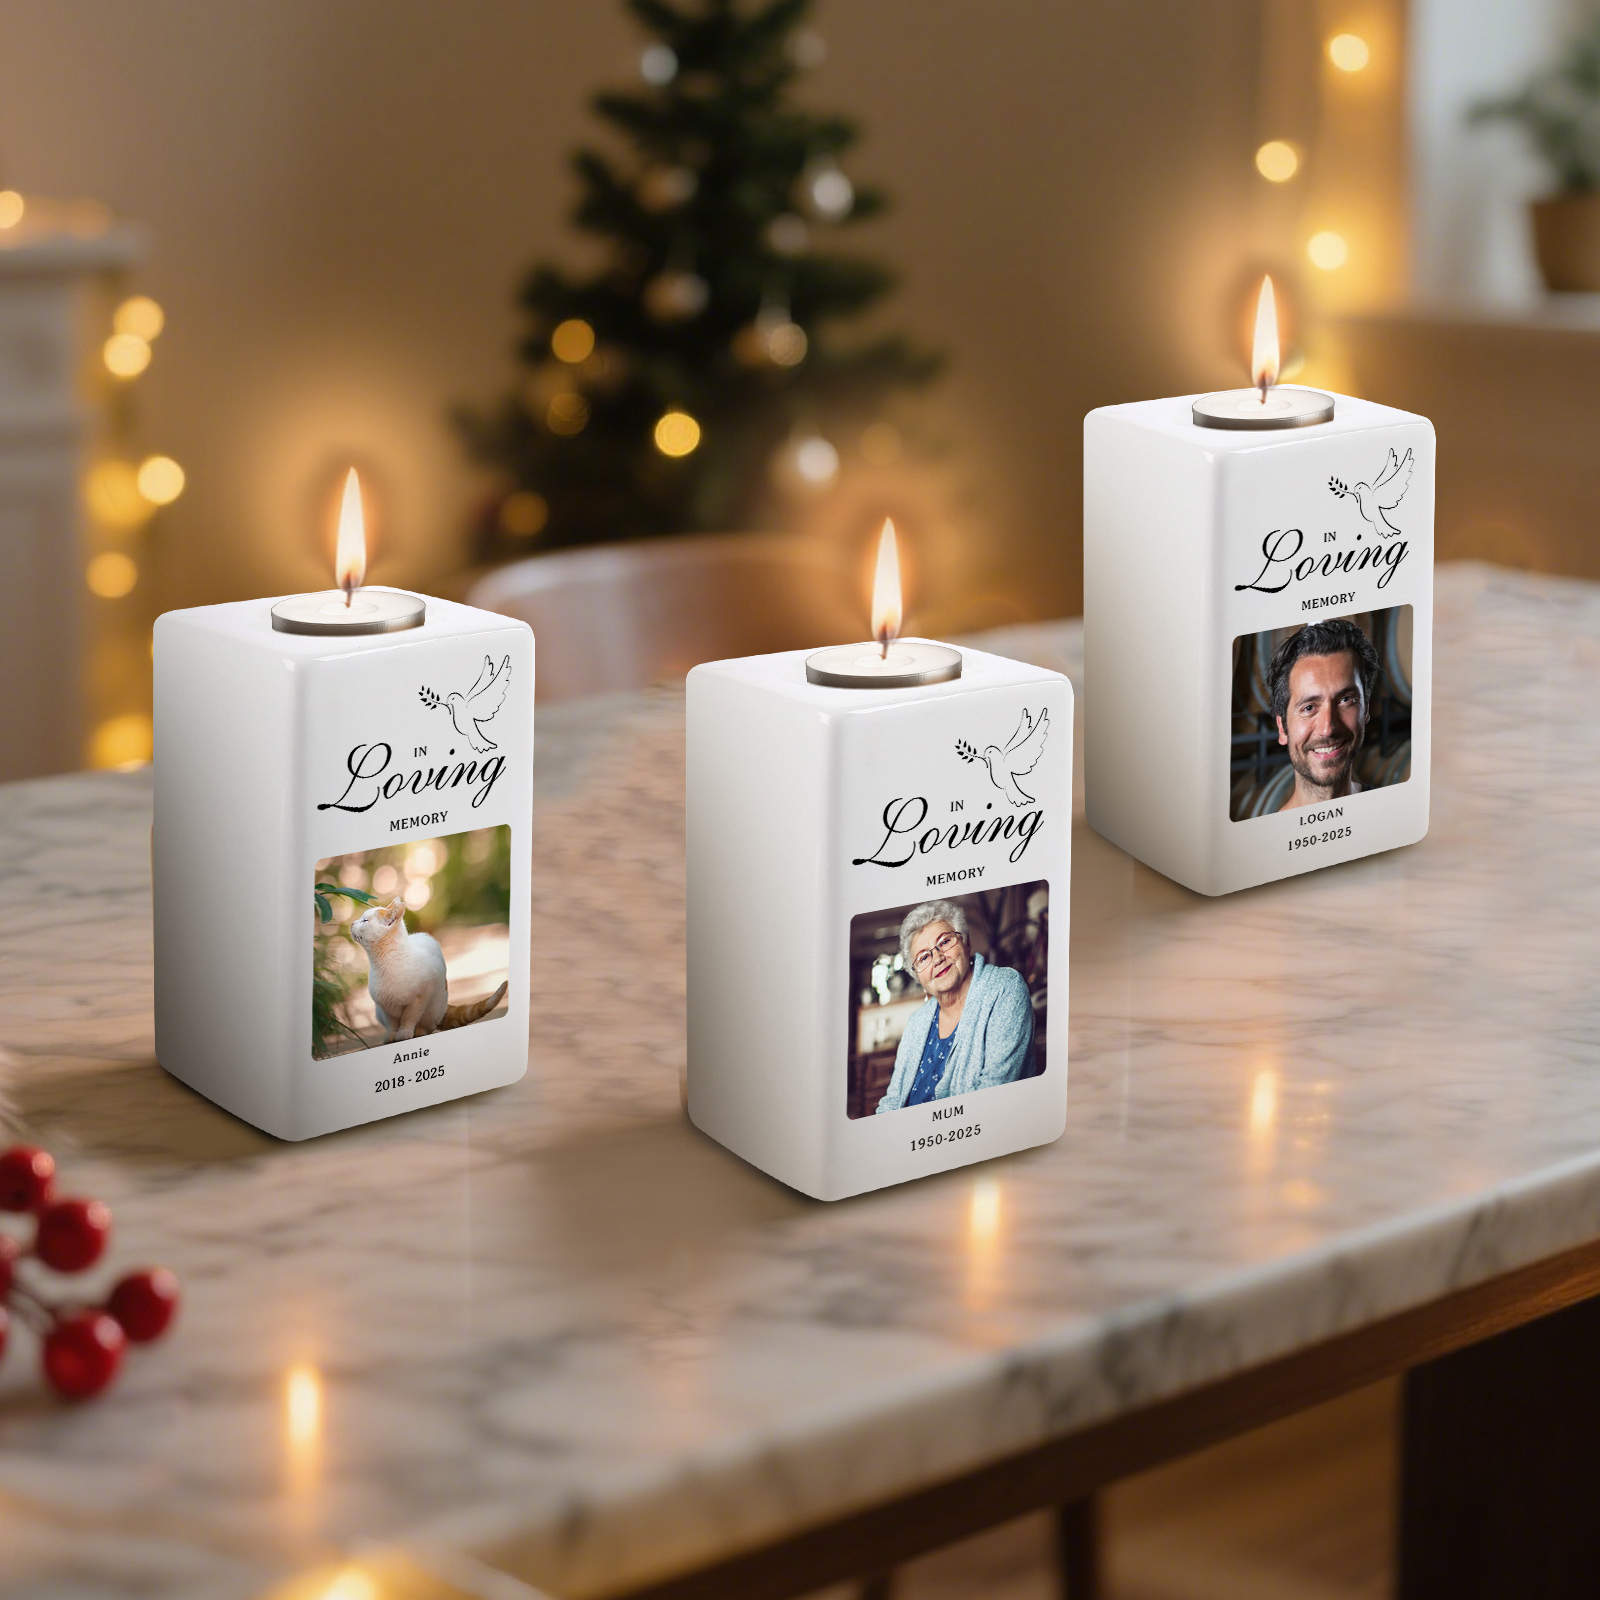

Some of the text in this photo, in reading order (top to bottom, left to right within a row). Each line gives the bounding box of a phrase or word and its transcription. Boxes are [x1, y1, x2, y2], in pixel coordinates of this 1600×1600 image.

[1323, 531, 1337, 543] IN
[1235, 529, 1409, 594] Loving
[1301, 592, 1356, 611] MEMORY
[414, 745, 428, 758] IN
[317, 743, 506, 814] Loving
[950, 799, 964, 813] IN
[1299, 806, 1344, 826] LOGAN
[389, 811, 449, 832] MEMORY
[852, 797, 1044, 869] Loving
[1288, 826, 1353, 851] 1950-2025
[926, 867, 985, 887] MEMORY
[393, 1047, 430, 1064] Annie
[375, 1075, 405, 1093] 2018
[415, 1065, 445, 1083] 2025
[932, 1104, 964, 1122] MUM
[910, 1123, 982, 1152] 1950-2025
